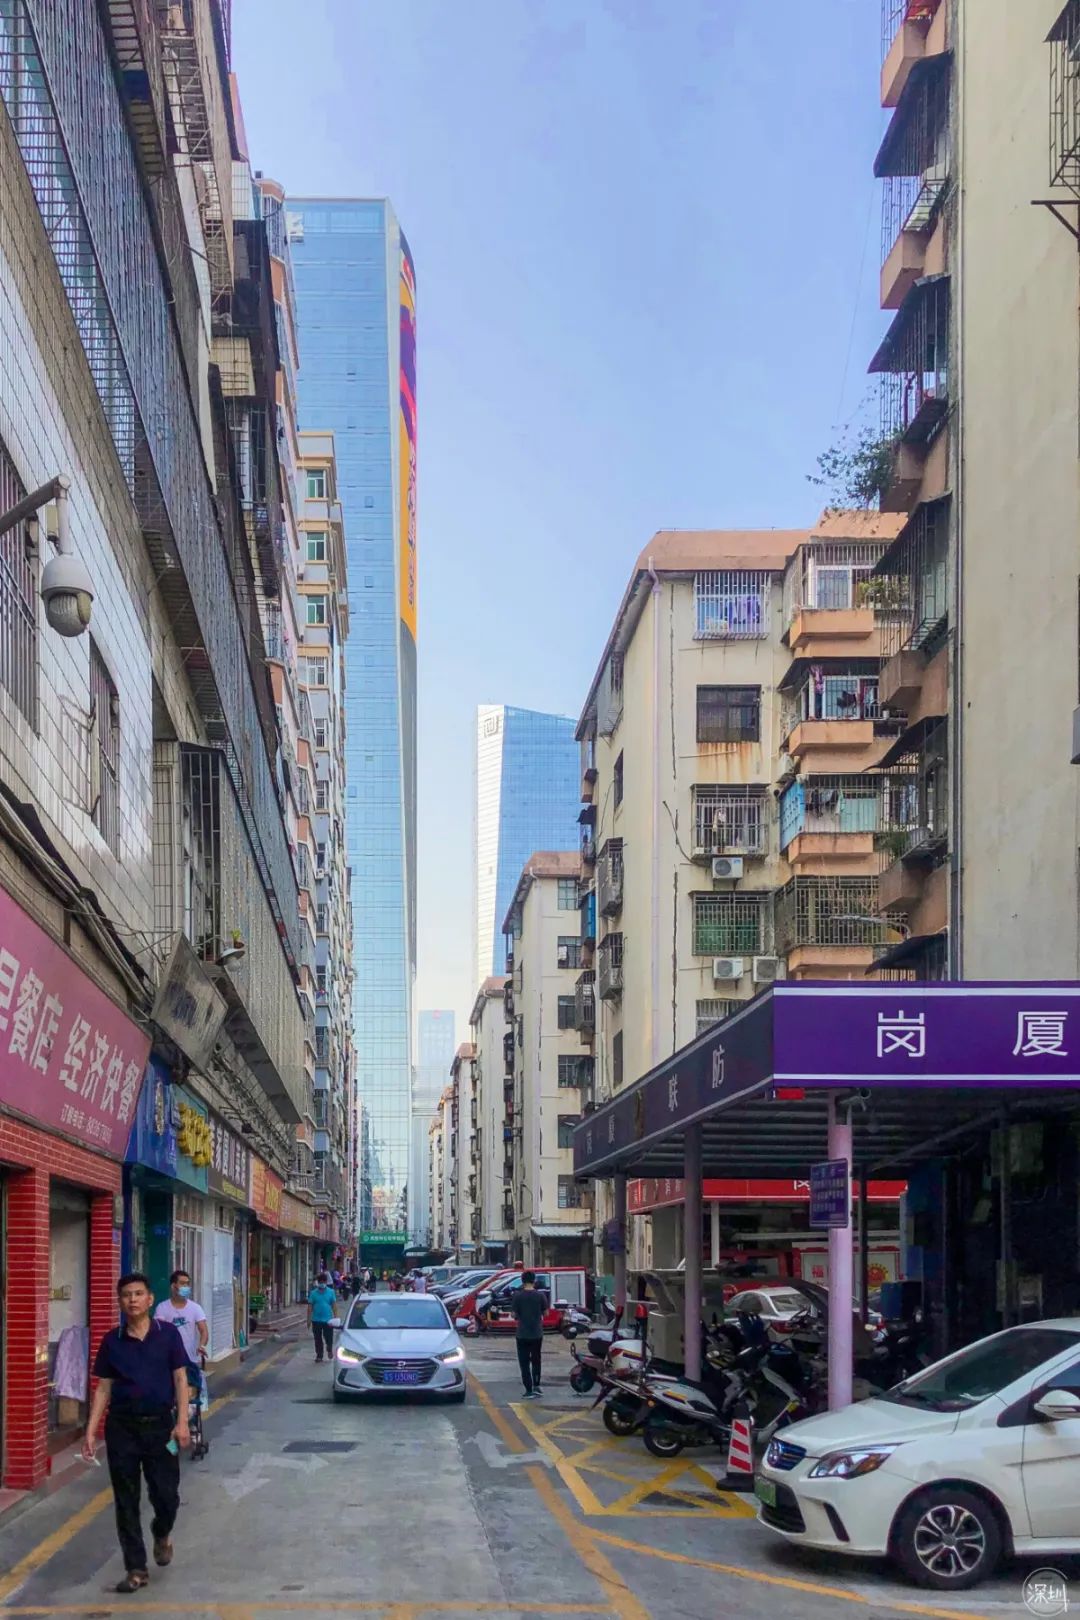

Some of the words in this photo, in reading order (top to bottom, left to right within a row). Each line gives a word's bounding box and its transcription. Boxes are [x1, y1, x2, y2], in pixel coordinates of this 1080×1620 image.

[59, 1012, 140, 1124] 经济快餐
[877, 1010, 1069, 1057] 岗厦
